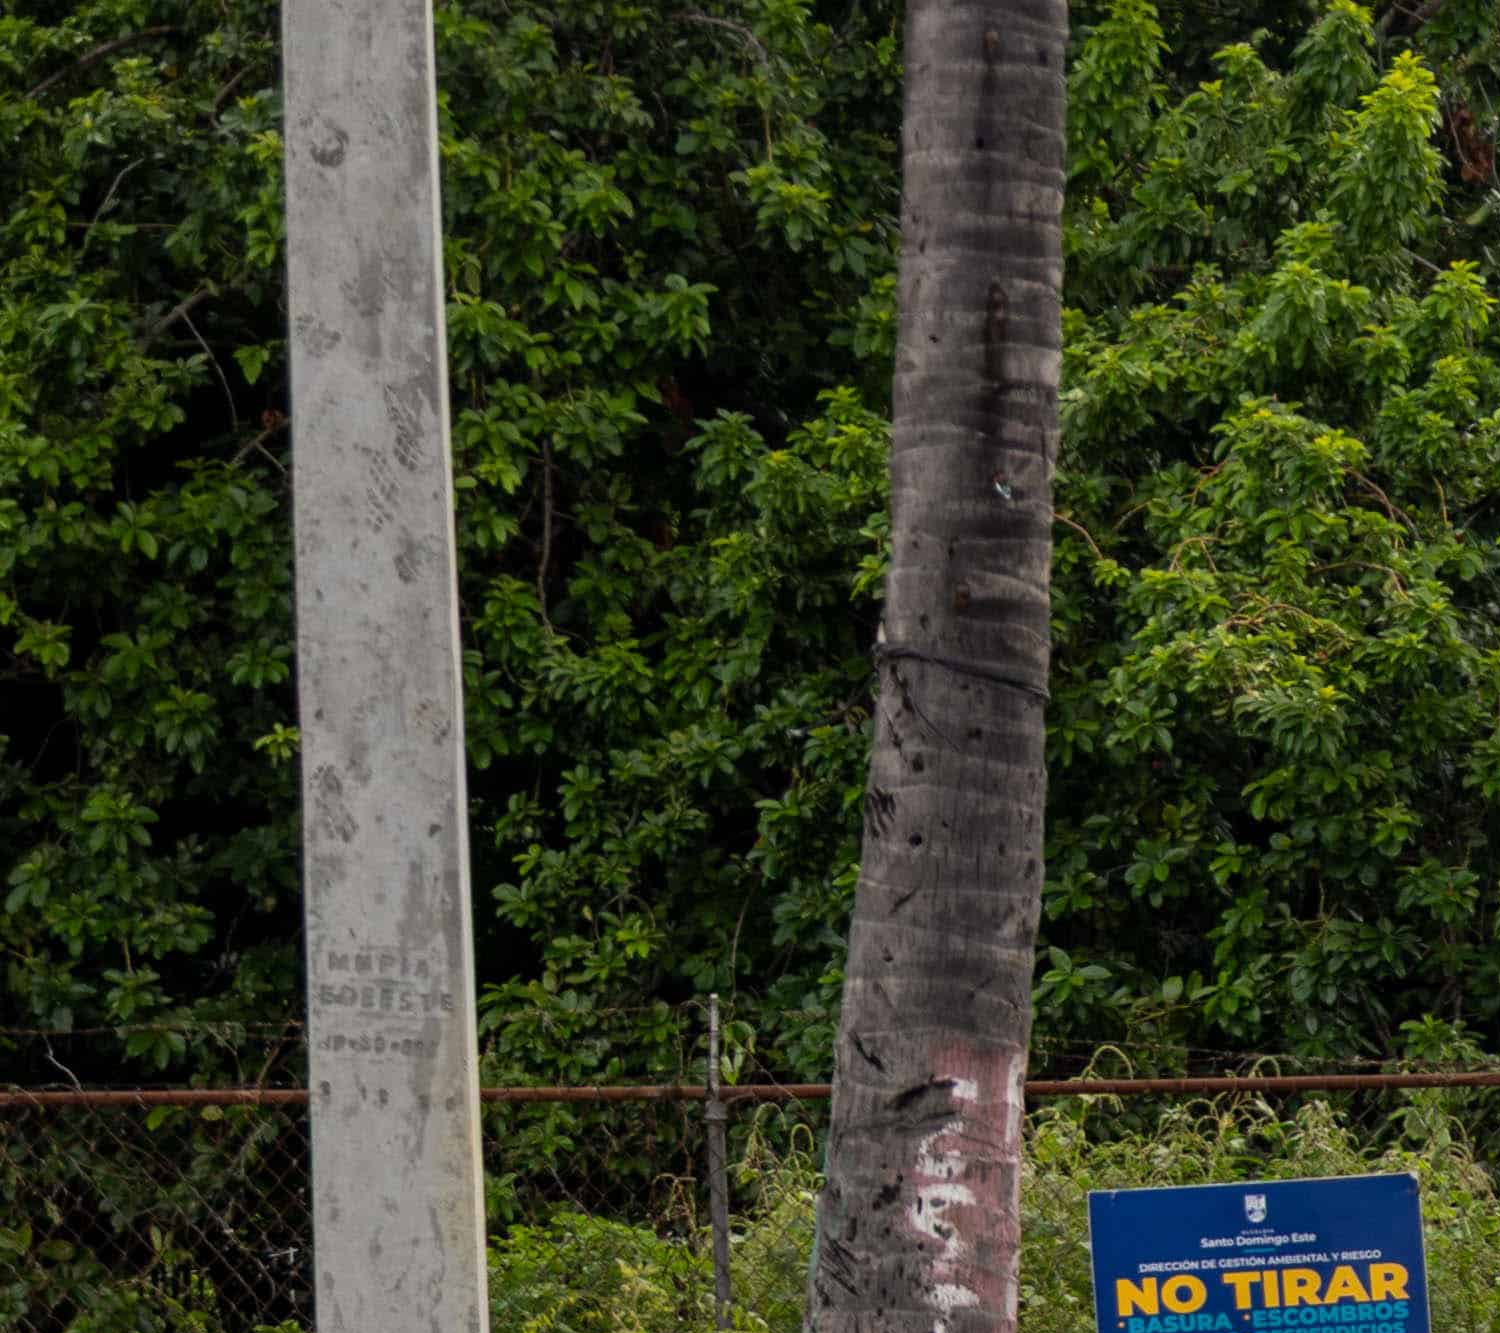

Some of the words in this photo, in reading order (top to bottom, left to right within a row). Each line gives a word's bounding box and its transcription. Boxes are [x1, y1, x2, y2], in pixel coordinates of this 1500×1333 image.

[1200, 1237, 1234, 1248] Santo
[1236, 1234, 1289, 1246] Domingo
[1291, 1232, 1317, 1243] Este
[1139, 1259, 1199, 1273] DIRECCIÓN
[1201, 1259, 1217, 1269] DE
[1218, 1255, 1265, 1269] GESTIÓN
[1267, 1252, 1330, 1265] AMBIENTAL
[1330, 1251, 1338, 1262] Y
[1341, 1249, 1382, 1261] RIESGO
[1115, 1273, 1208, 1317] NO
[1221, 1262, 1410, 1310] TIRAR
[1251, 1300, 1409, 1328] ESCOMBROS
